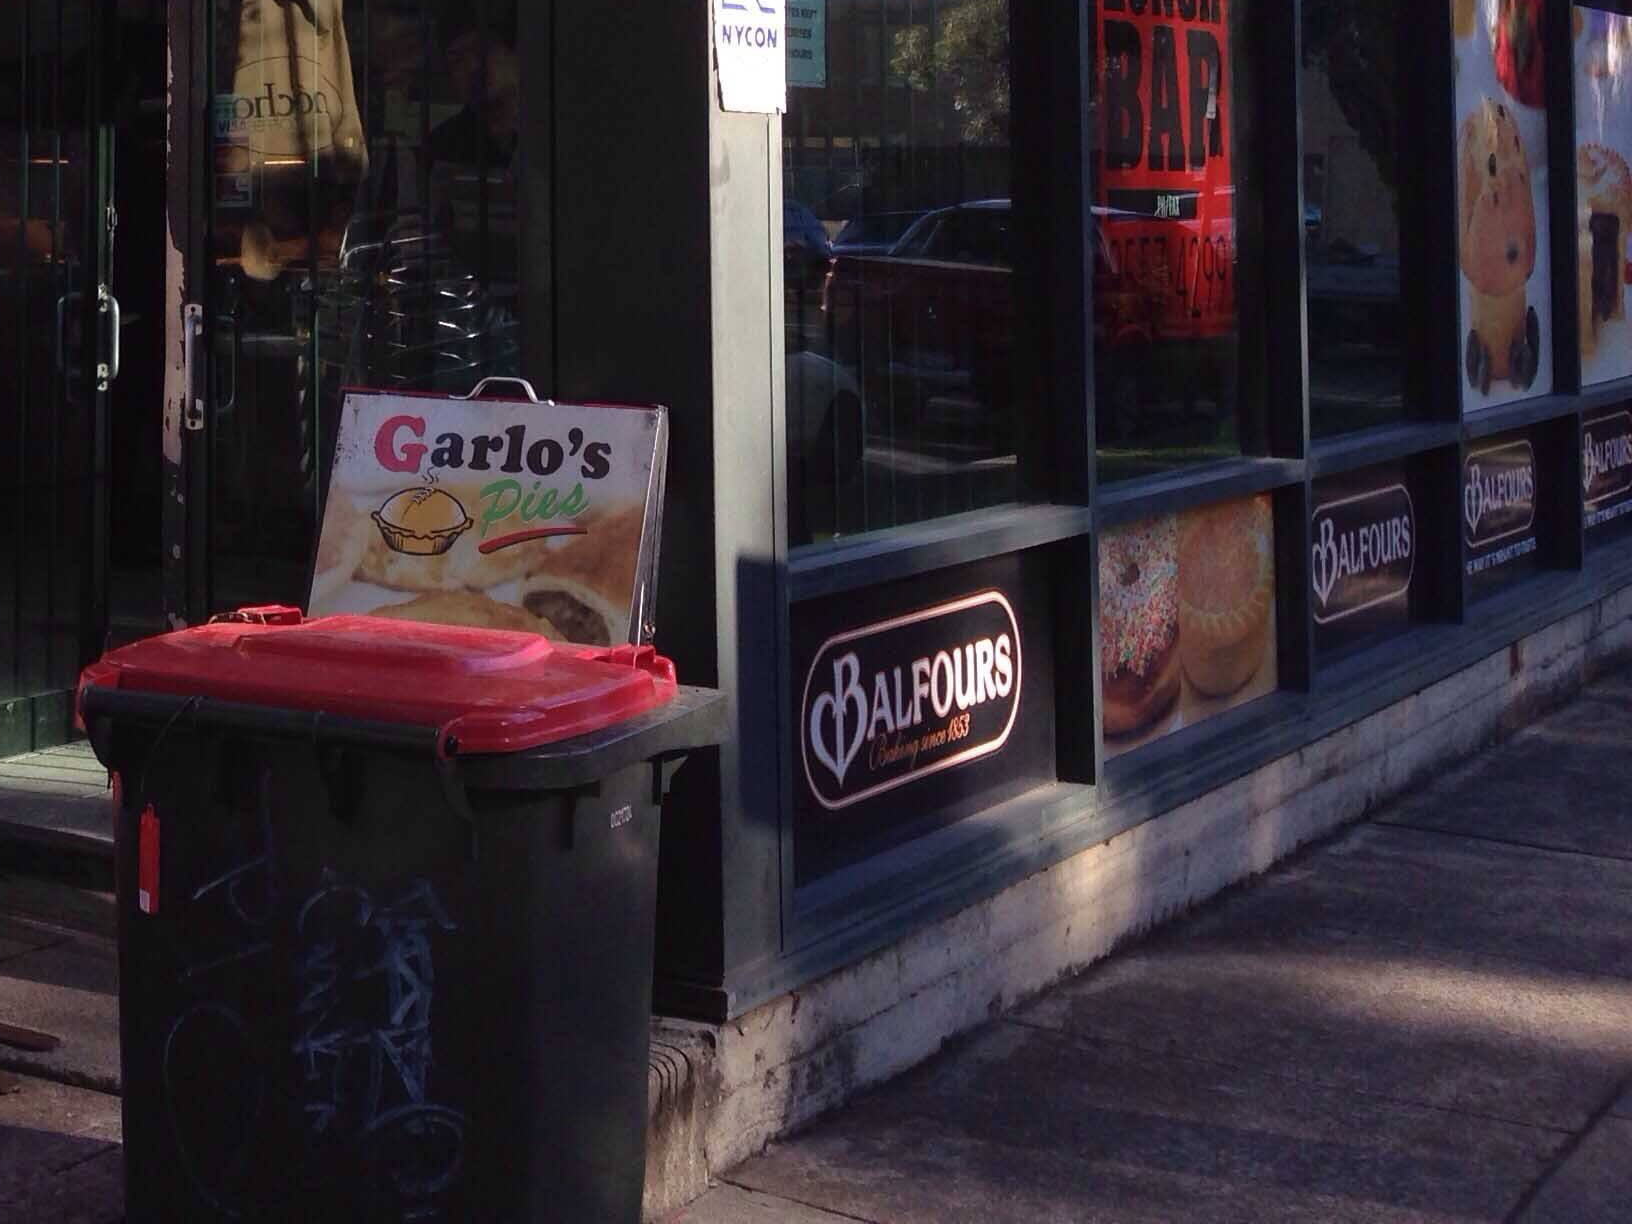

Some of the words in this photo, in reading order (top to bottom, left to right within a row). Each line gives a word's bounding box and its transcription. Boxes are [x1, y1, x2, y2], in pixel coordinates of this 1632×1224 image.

[722, 24, 778, 48] NYCON
[374, 414, 612, 480] Garlo's
[479, 477, 589, 539] Pies
[1464, 463, 1534, 536] BALFOURS
[1312, 514, 1411, 608] BALFOURS
[810, 633, 1013, 789] BALFOURS
